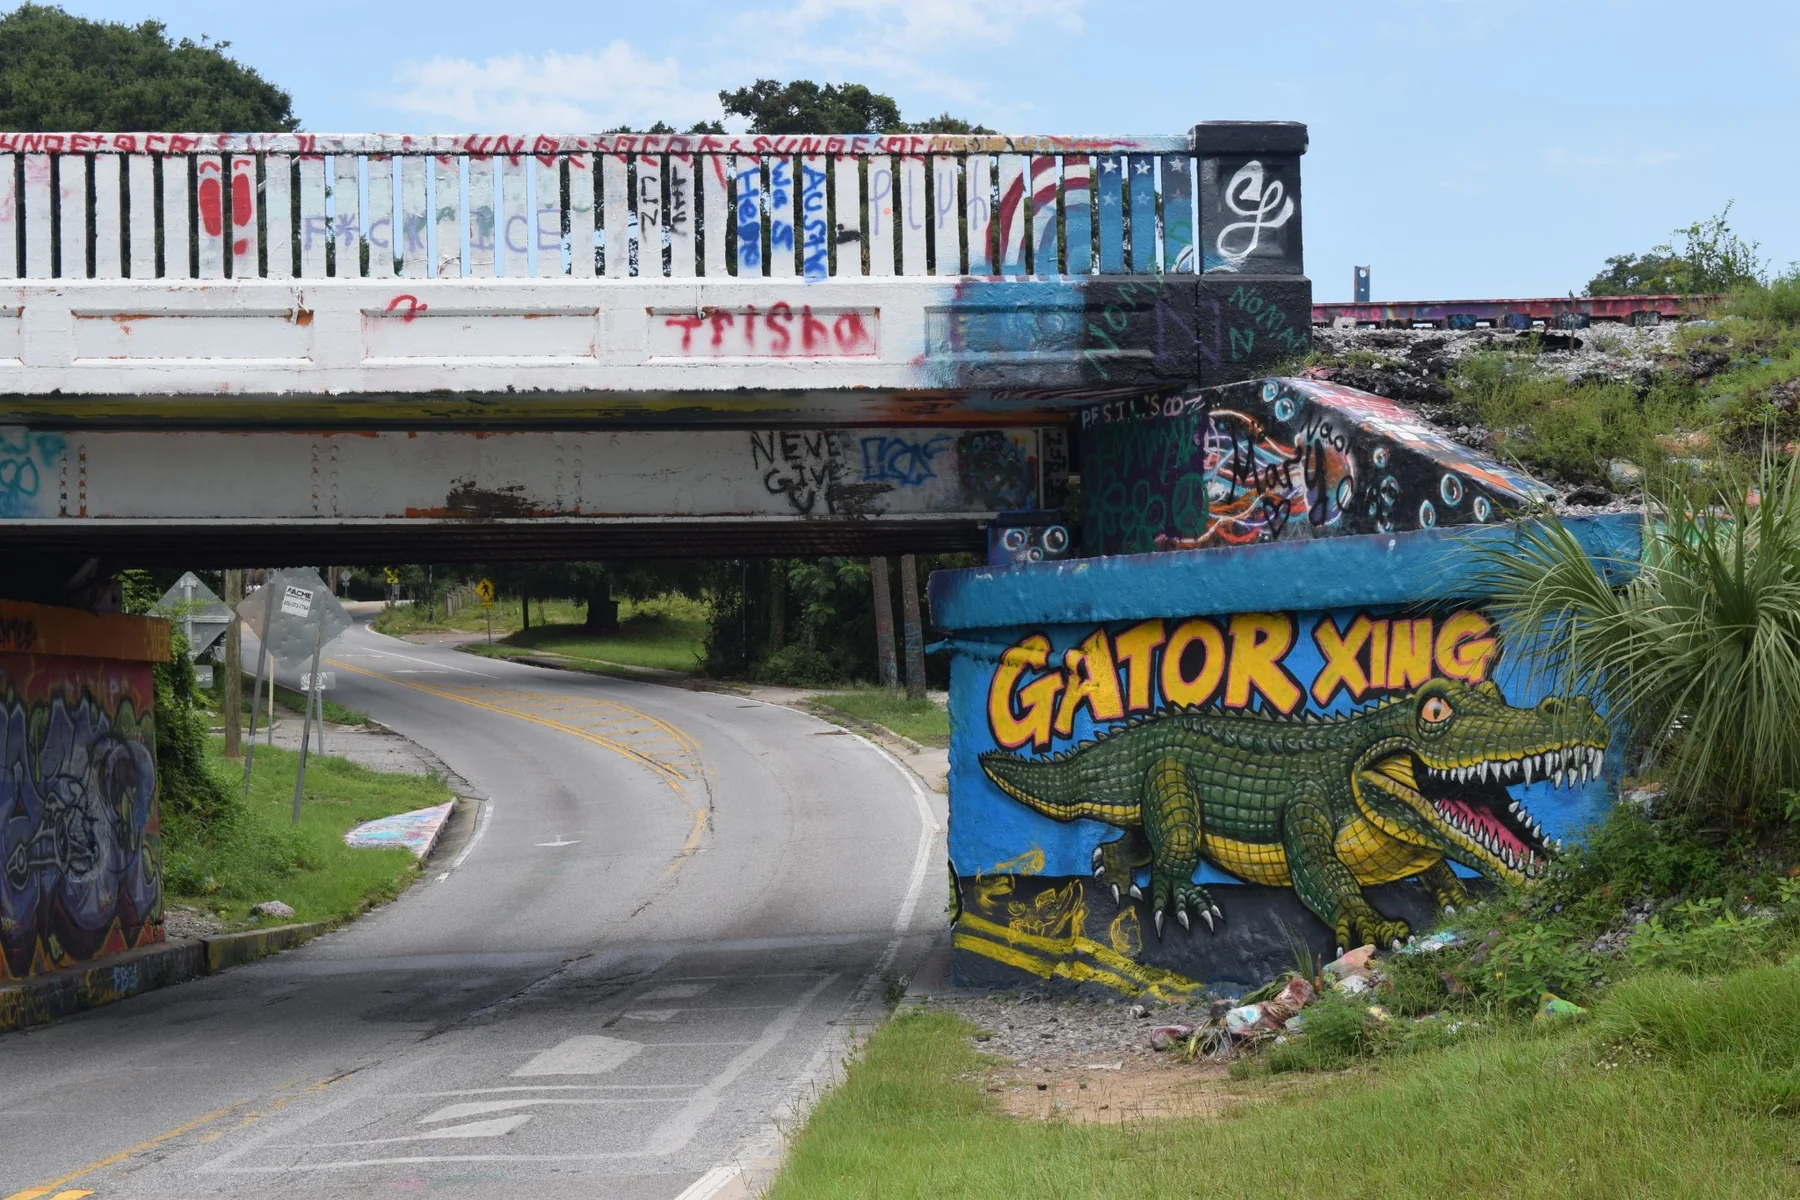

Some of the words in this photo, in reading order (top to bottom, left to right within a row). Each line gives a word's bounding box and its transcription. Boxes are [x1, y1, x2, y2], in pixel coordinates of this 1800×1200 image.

[469, 208, 561, 252] ICE
[1227, 423, 1327, 526] Mary
[988, 613, 1302, 750] GATOR
[1313, 610, 1497, 705] XING
